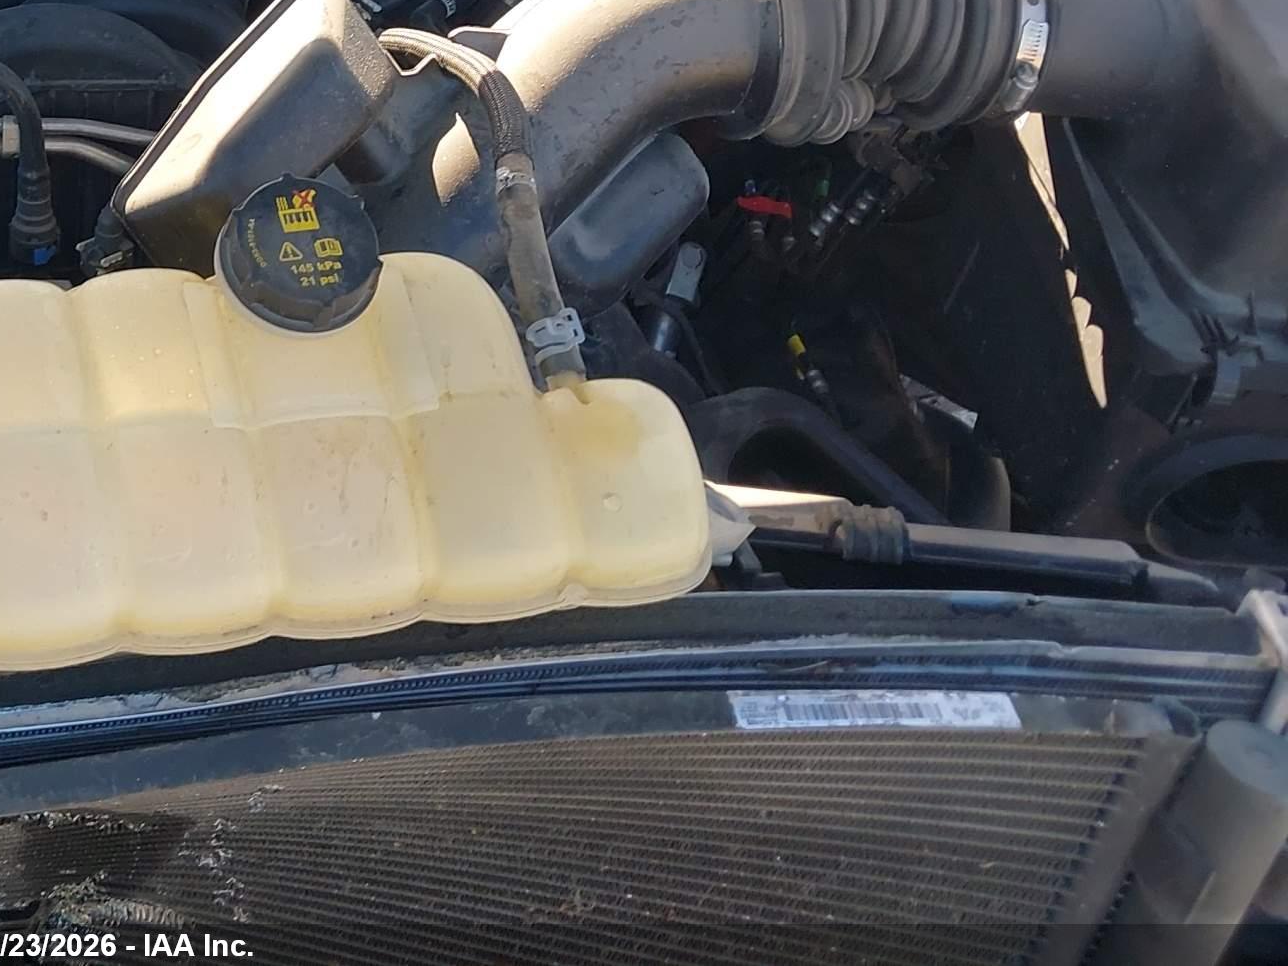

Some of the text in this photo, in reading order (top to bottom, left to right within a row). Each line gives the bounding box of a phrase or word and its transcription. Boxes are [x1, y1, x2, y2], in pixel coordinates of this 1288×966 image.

[290, 260, 342, 274] 145 kPa
[300, 273, 339, 286] 21 psi
